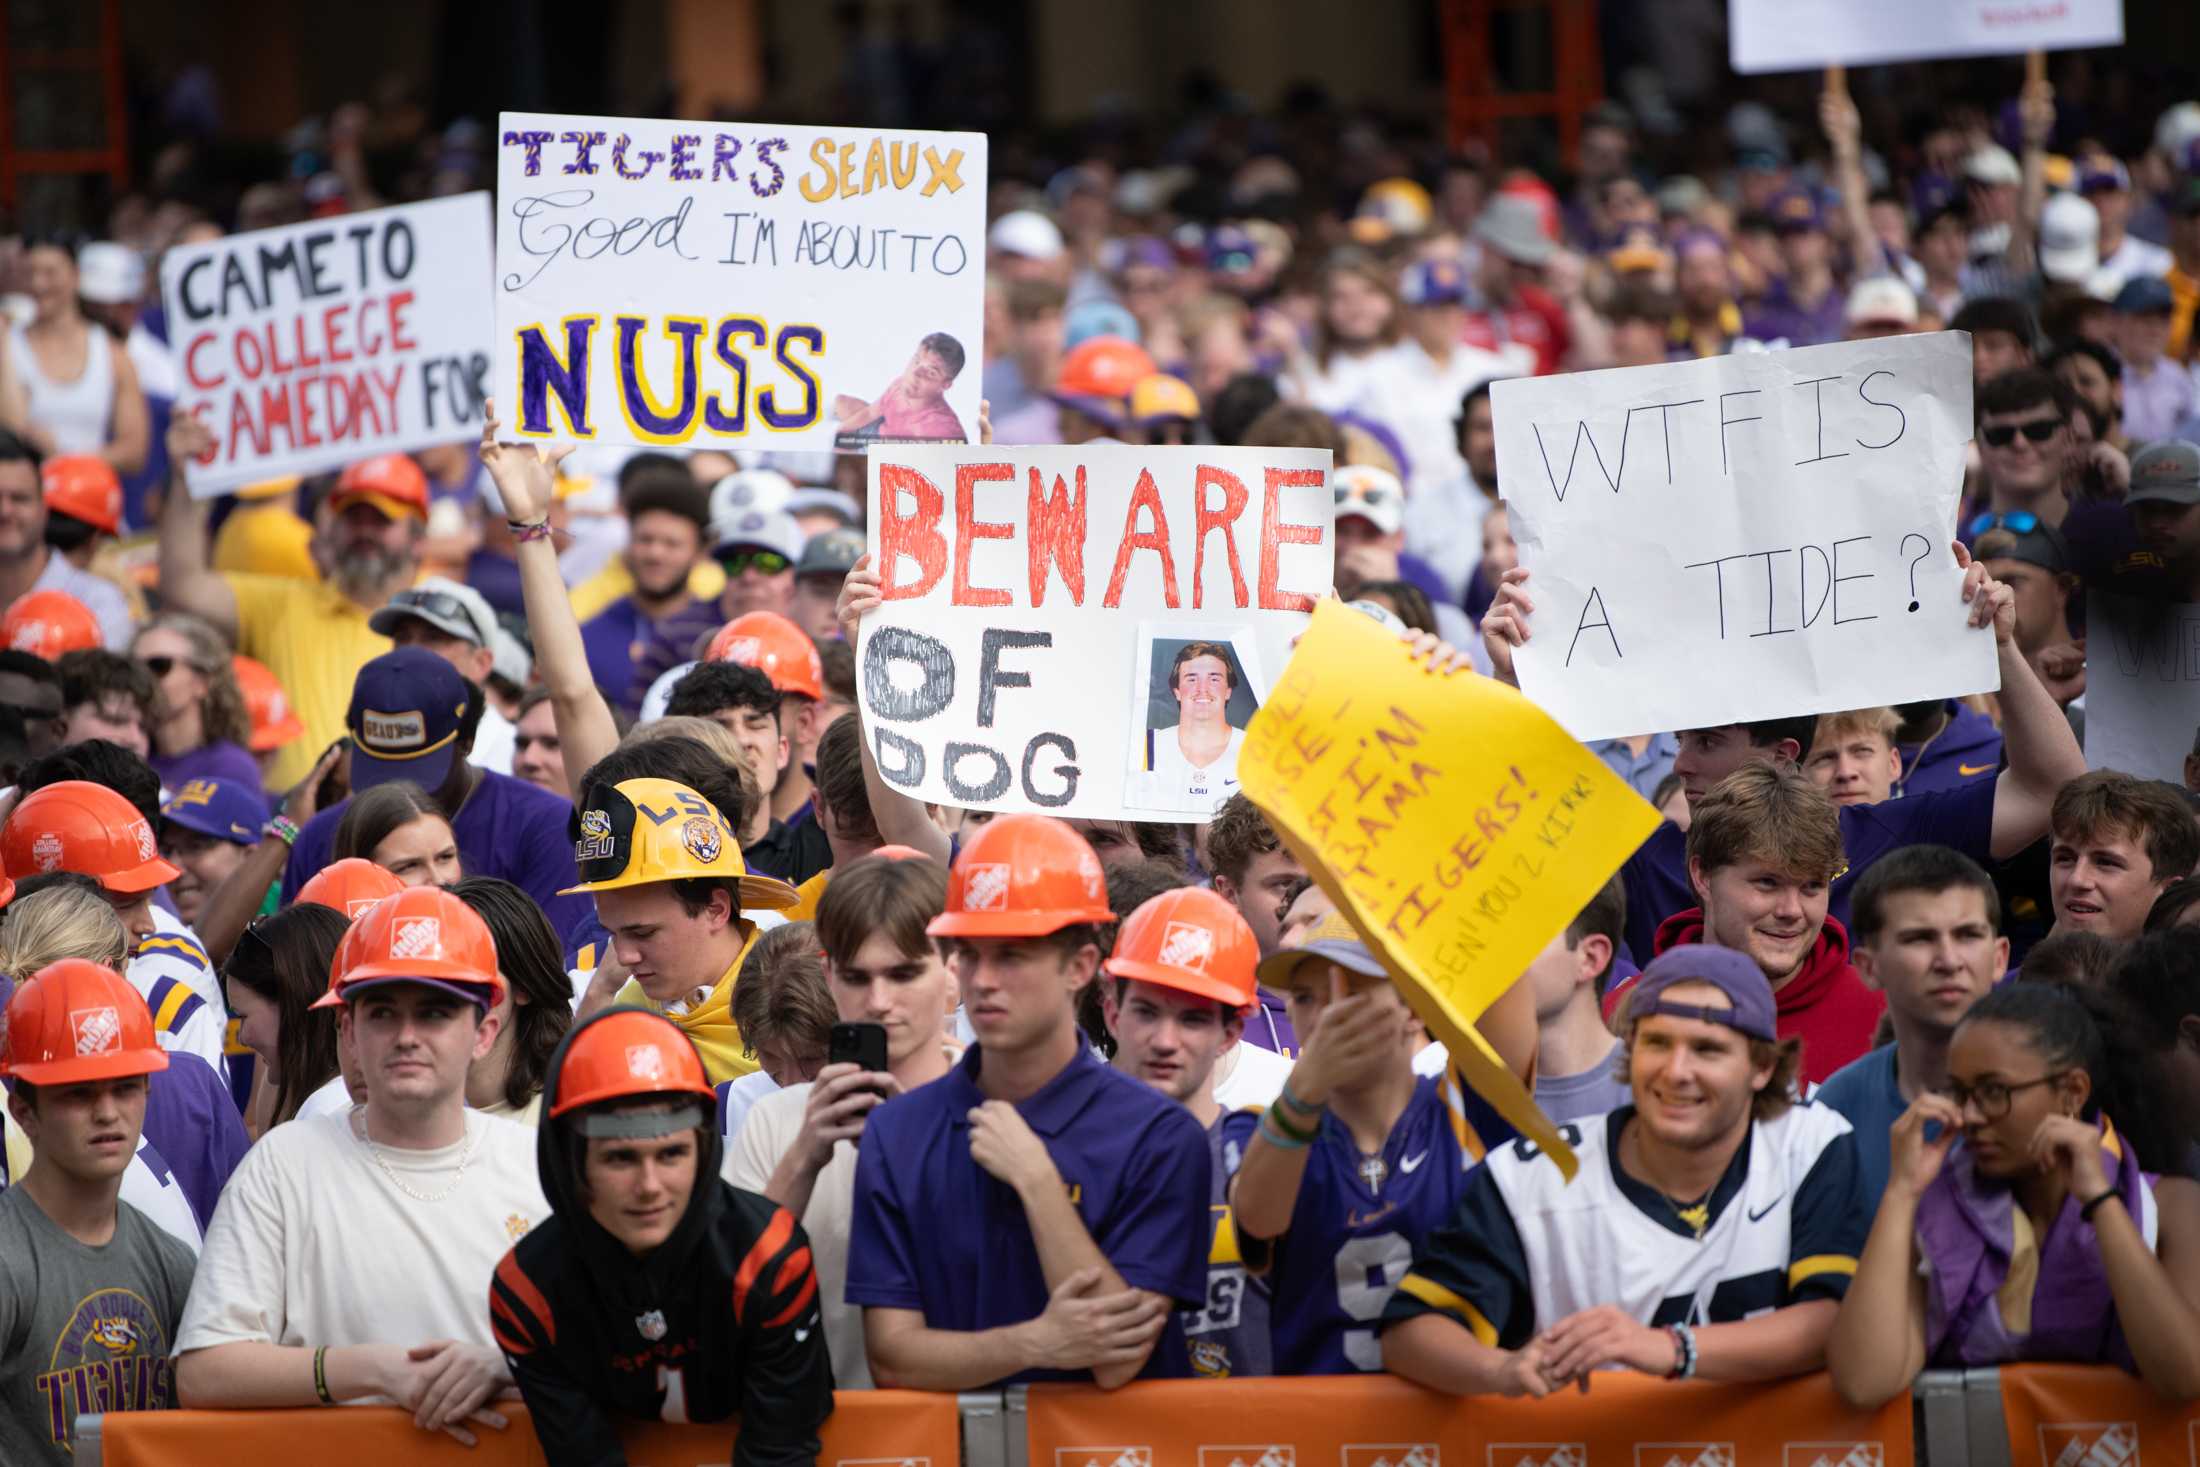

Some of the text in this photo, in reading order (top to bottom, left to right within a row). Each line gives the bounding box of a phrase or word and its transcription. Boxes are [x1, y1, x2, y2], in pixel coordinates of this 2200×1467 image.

[799, 136, 966, 202] SEAUX
[179, 219, 416, 320] CAME TO
[502, 189, 967, 292] Good I'M ABOUT TO
[184, 290, 417, 391] COLLEGE
[421, 352, 490, 429] FOR
[515, 311, 828, 445] NUSS
[1531, 370, 1906, 503] WTF IS
[879, 462, 1325, 613] BEWARE
[863, 624, 1053, 729] OF
[1565, 586, 1624, 668] A
[873, 725, 1081, 808] DOG
[574, 835, 615, 862] LSU
[1386, 765, 1539, 941] TIGERS!
